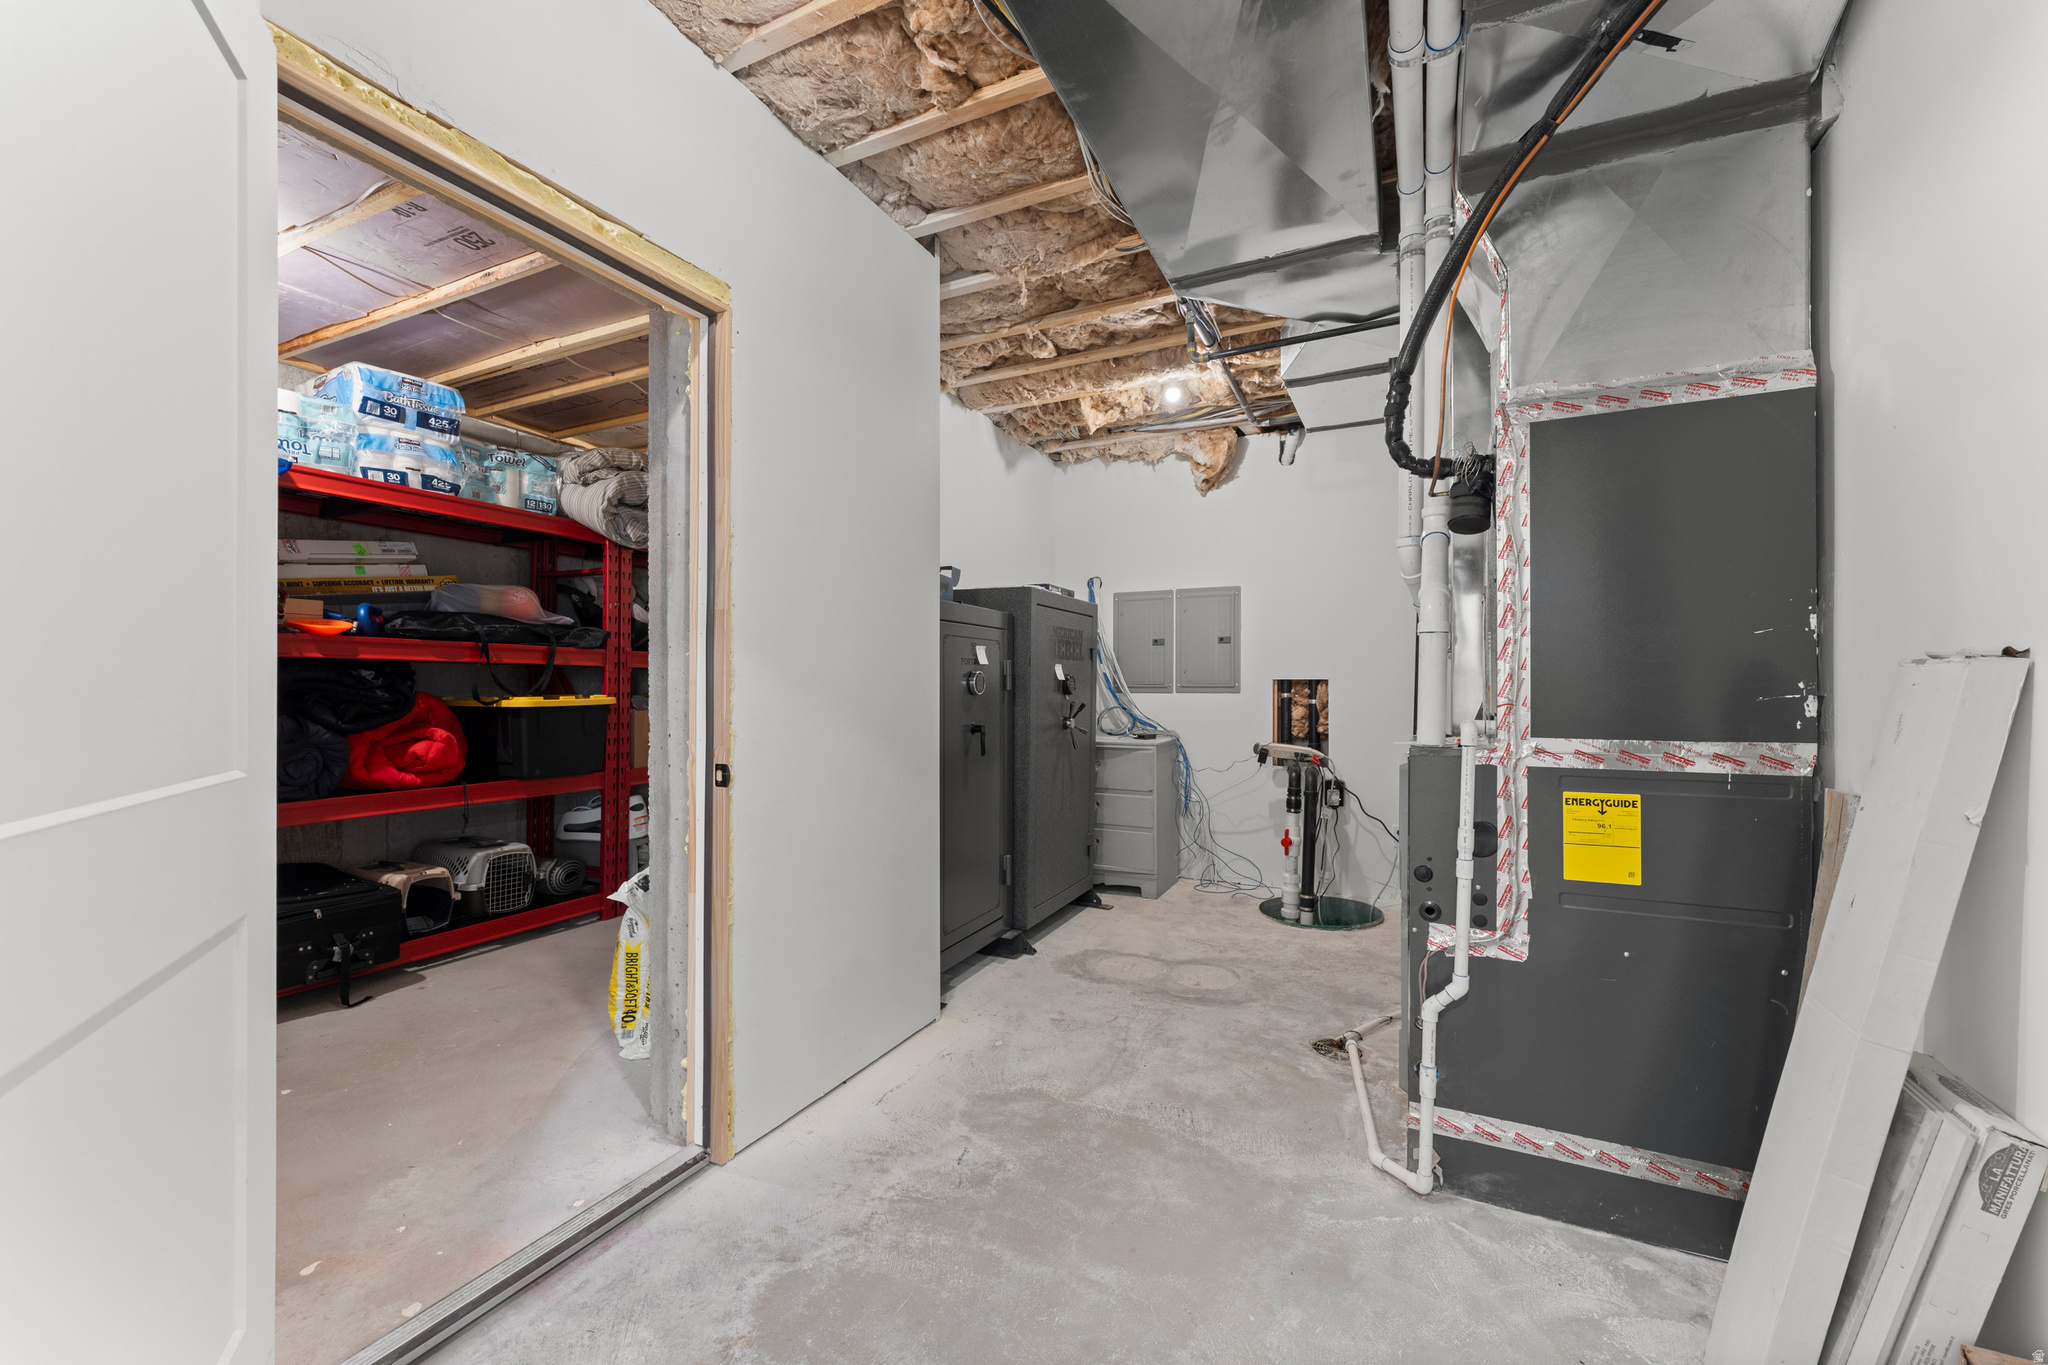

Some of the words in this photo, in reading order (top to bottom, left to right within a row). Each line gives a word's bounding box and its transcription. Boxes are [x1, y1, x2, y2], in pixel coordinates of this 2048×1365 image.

[392, 202, 428, 218] R-10
[453, 231, 496, 250] 250
[382, 390, 410, 407] Bath
[384, 405, 398, 414] 30
[428, 417, 449, 428] 425
[278, 438, 312, 456] Tow
[488, 453, 527, 468] Towel
[386, 472, 400, 480] 30
[1565, 797, 1638, 809] ENERGYGUIDE
[1989, 1168, 2004, 1182] LA
[1989, 1146, 2028, 1215] MANIFATTURA
[2001, 1201, 2013, 1220] GRES
